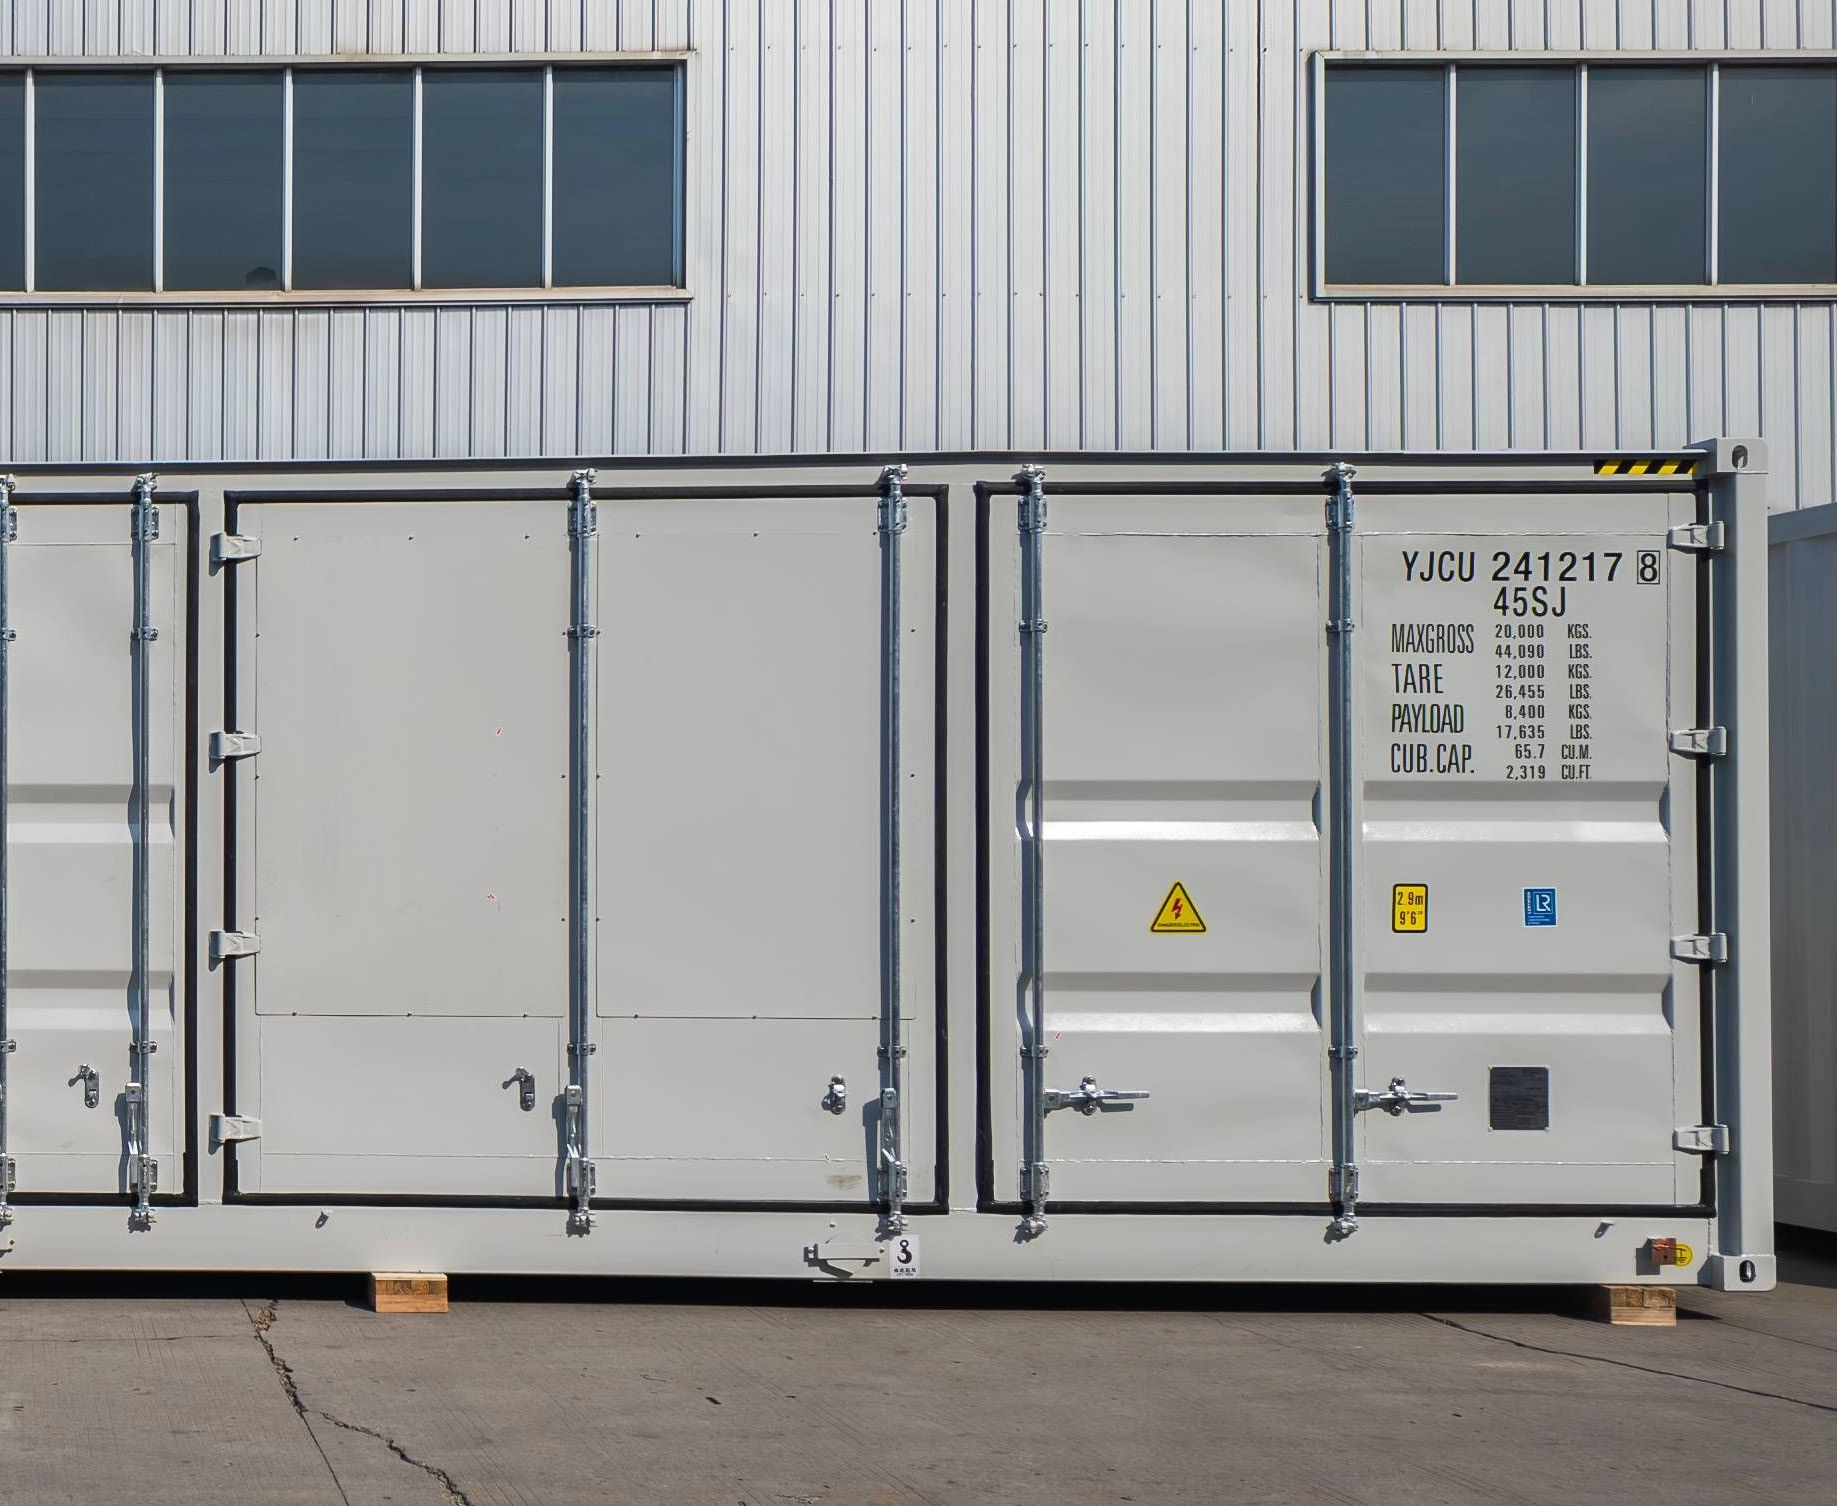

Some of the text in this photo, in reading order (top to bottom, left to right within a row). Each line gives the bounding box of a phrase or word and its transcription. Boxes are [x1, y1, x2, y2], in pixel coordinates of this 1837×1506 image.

[1402, 551, 1658, 582] YJCU 241217 8
[1494, 586, 1566, 617] 45SJ
[1392, 624, 1475, 654] MAXGROSS
[1495, 624, 1592, 639] 20,000 KGS.
[1495, 644, 1544, 659] 44,090
[1392, 664, 1444, 693] TARE
[1496, 664, 1591, 680] 12,000 KGS.
[1496, 684, 1591, 700] 26,455 LBS.
[1392, 704, 1464, 733] PAYLOAD
[1506, 705, 1544, 720] 8,400
[1496, 724, 1591, 740] 17,635 LBS.
[1391, 743, 1475, 773] CUB.CAP.
[1515, 744, 1592, 760] 65.7 CU.M.
[1506, 765, 1545, 780] 2,319
[1536, 894, 1551, 911] LR
